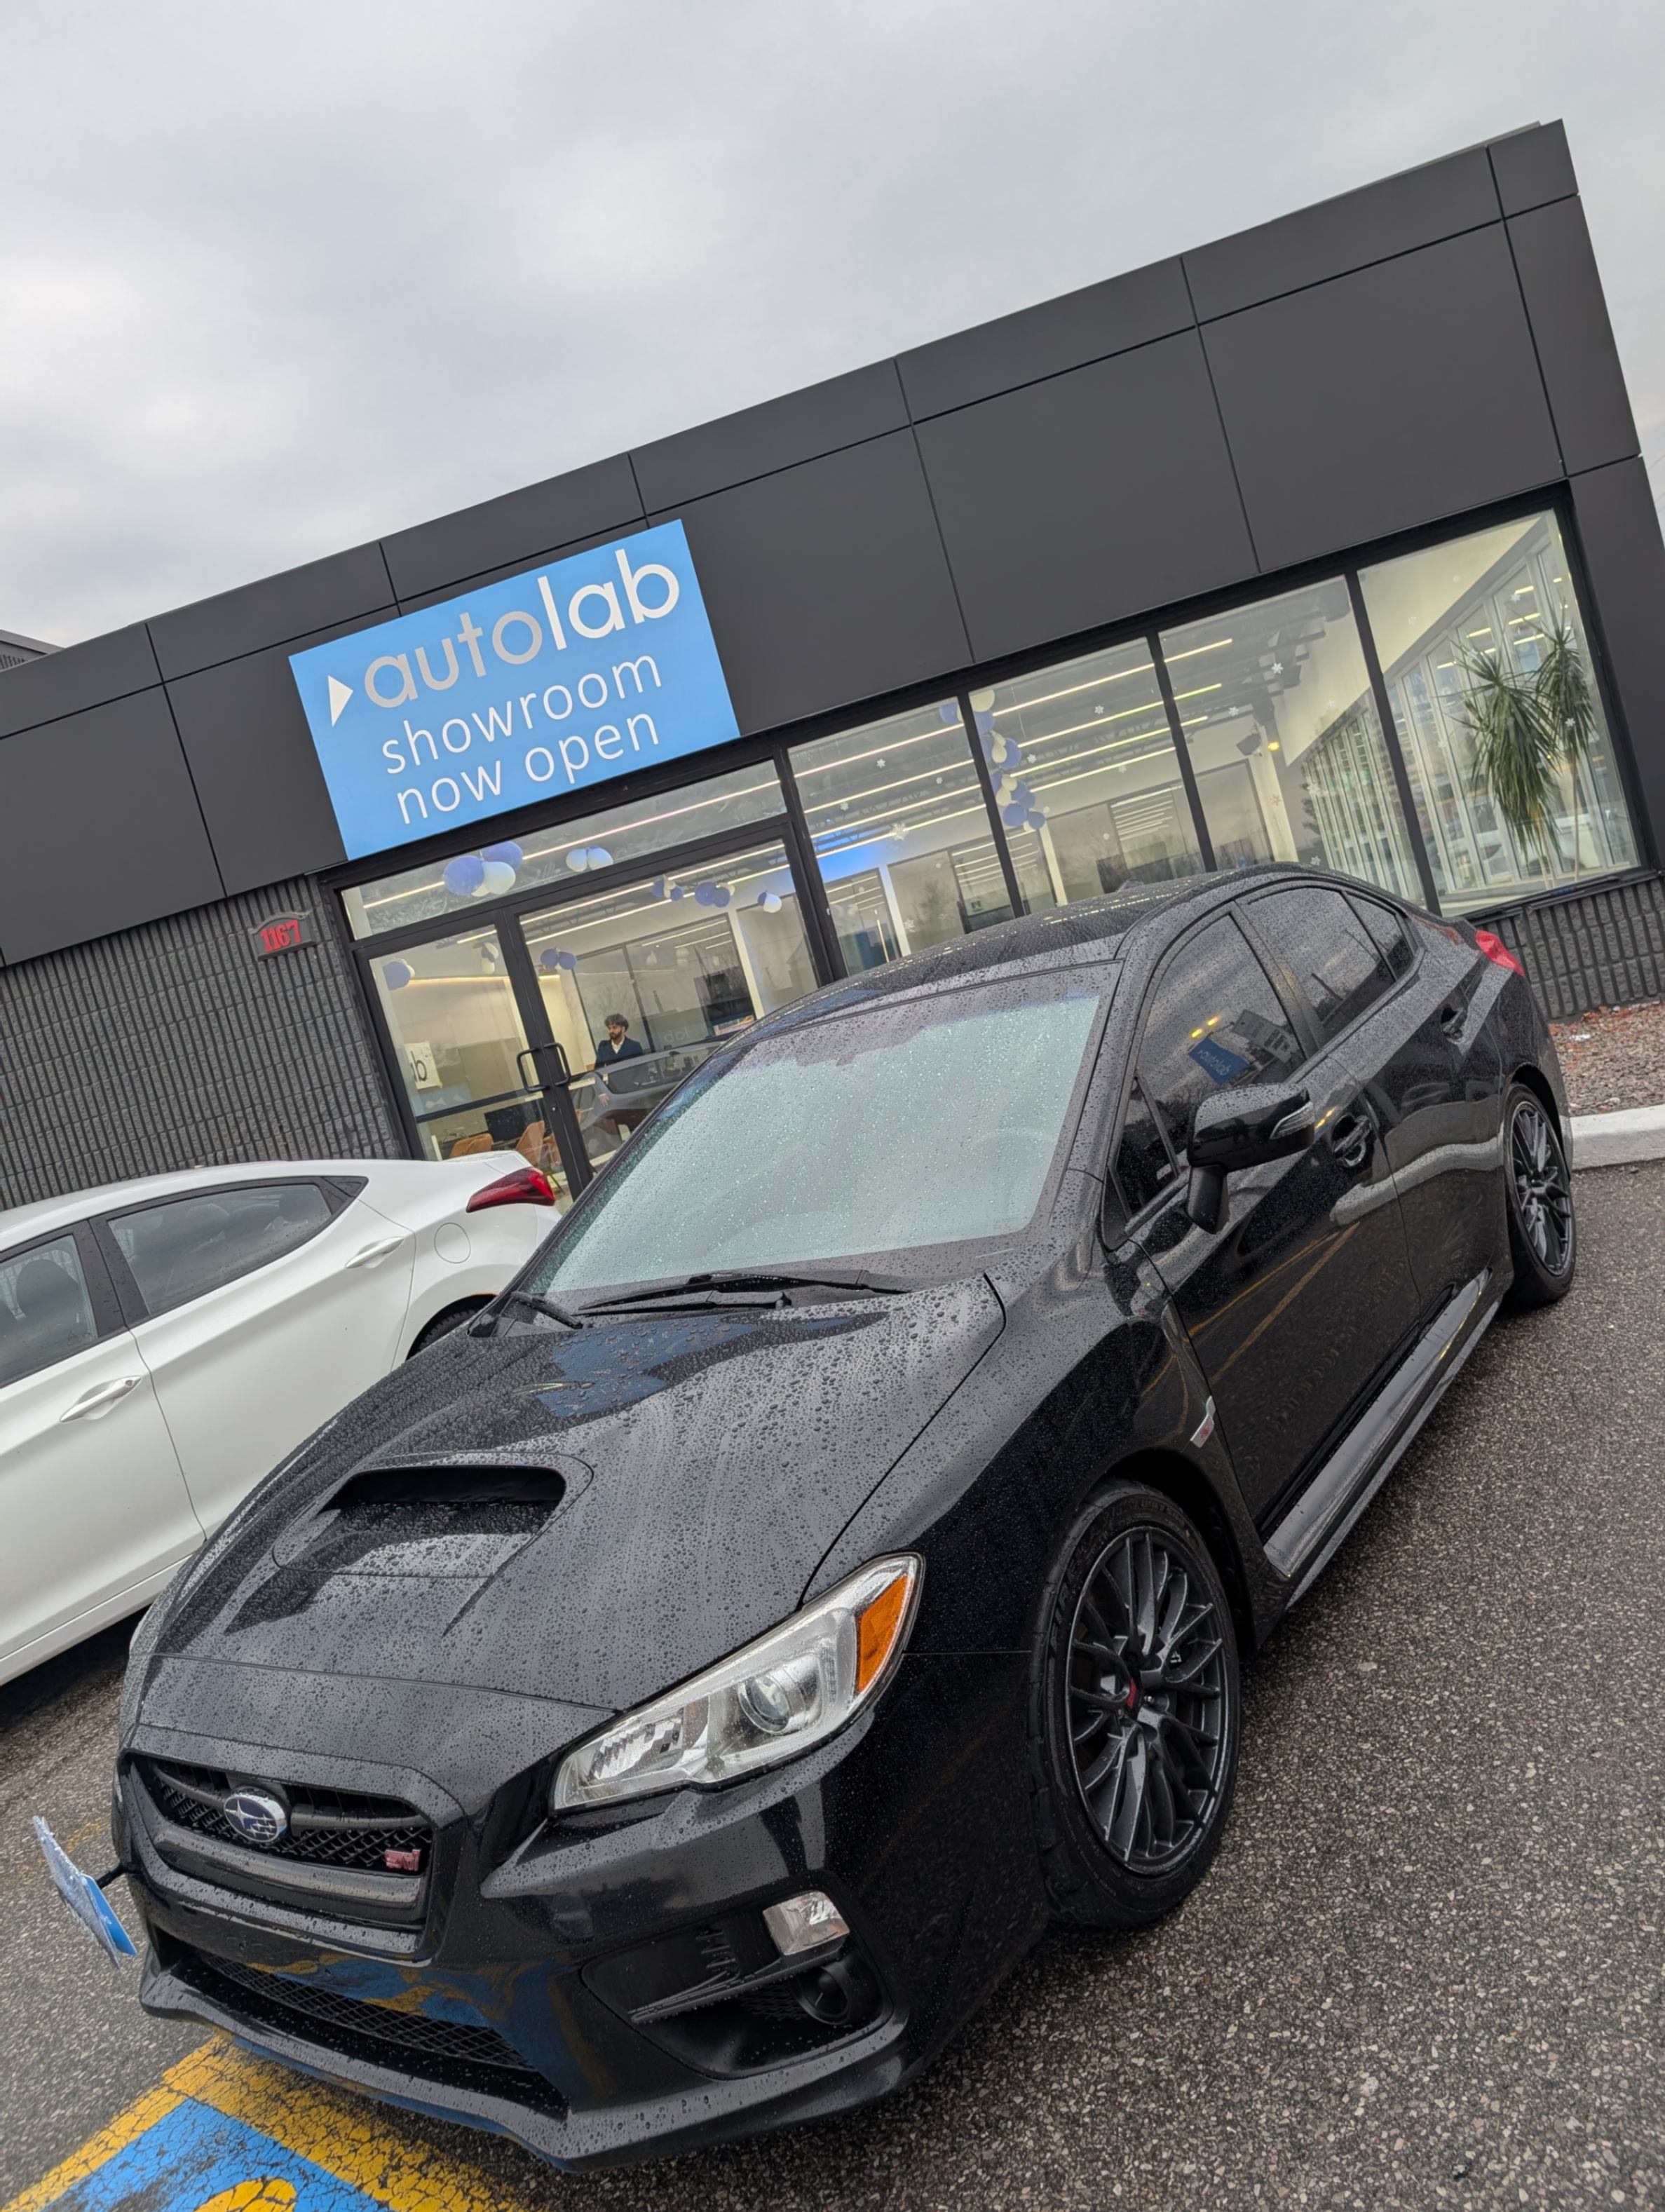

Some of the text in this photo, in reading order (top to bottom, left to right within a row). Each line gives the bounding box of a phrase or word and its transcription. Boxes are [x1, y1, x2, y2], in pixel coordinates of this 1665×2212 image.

[364, 548, 680, 708] autolab
[381, 655, 662, 774] showroom
[397, 712, 659, 824] now open
[260, 919, 302, 952] 1167
